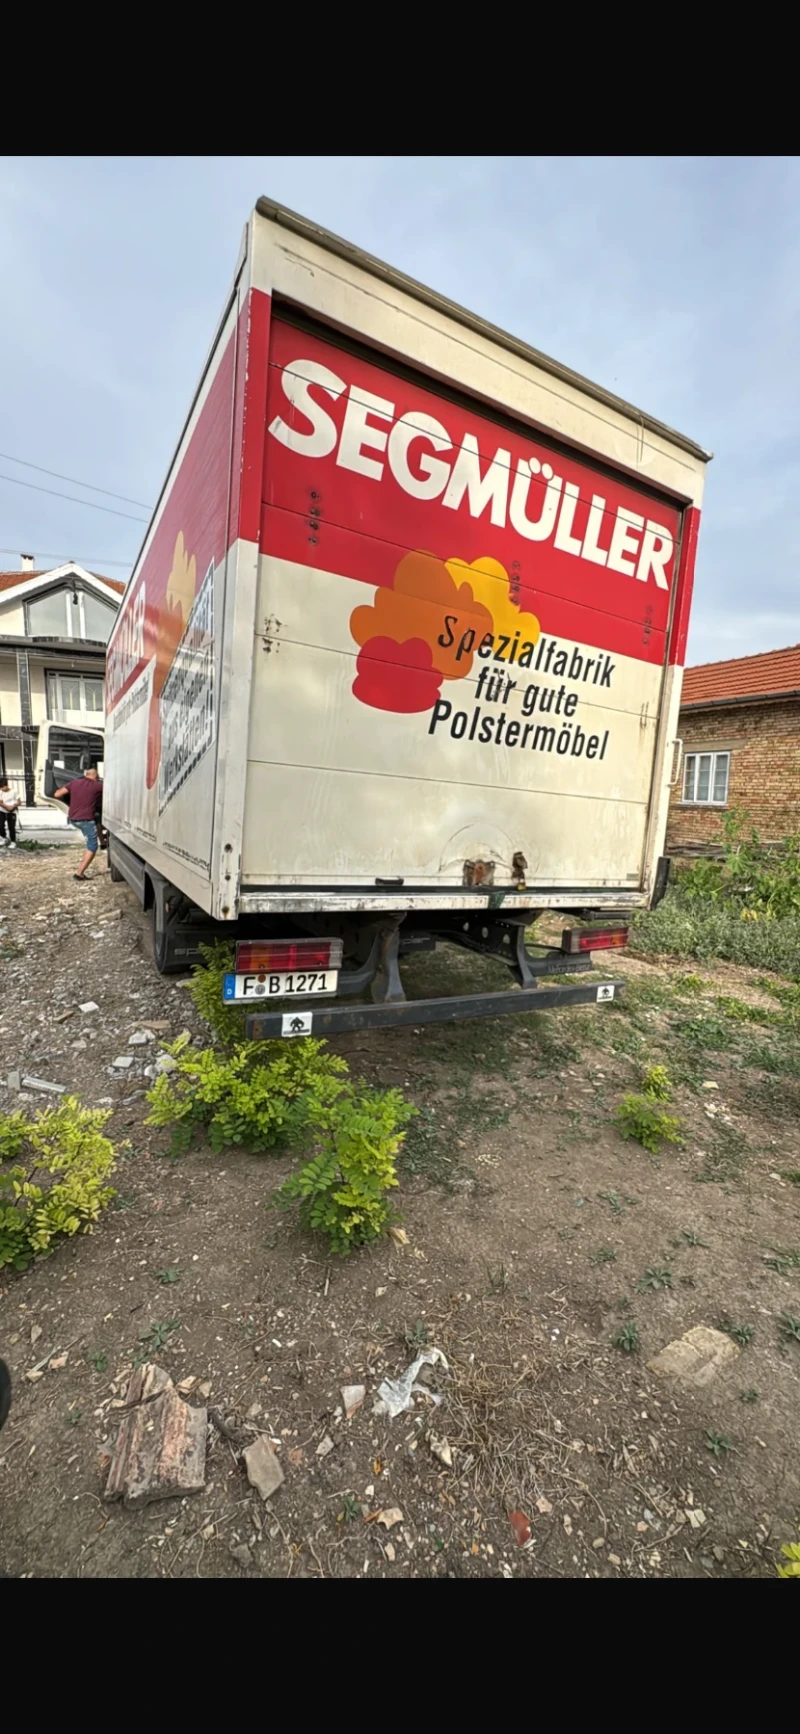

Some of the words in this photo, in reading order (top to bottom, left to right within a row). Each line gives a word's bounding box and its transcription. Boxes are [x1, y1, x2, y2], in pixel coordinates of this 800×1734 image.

[268, 358, 674, 591] SEGMÜLLER
[437, 615, 616, 688] Spezialfabrik
[474, 666, 518, 705] für
[520, 683, 579, 717] gute
[427, 698, 610, 761] Polstermöbel
[243, 976, 256, 995] F
[268, 975, 281, 994] B
[285, 973, 328, 993] 1271
